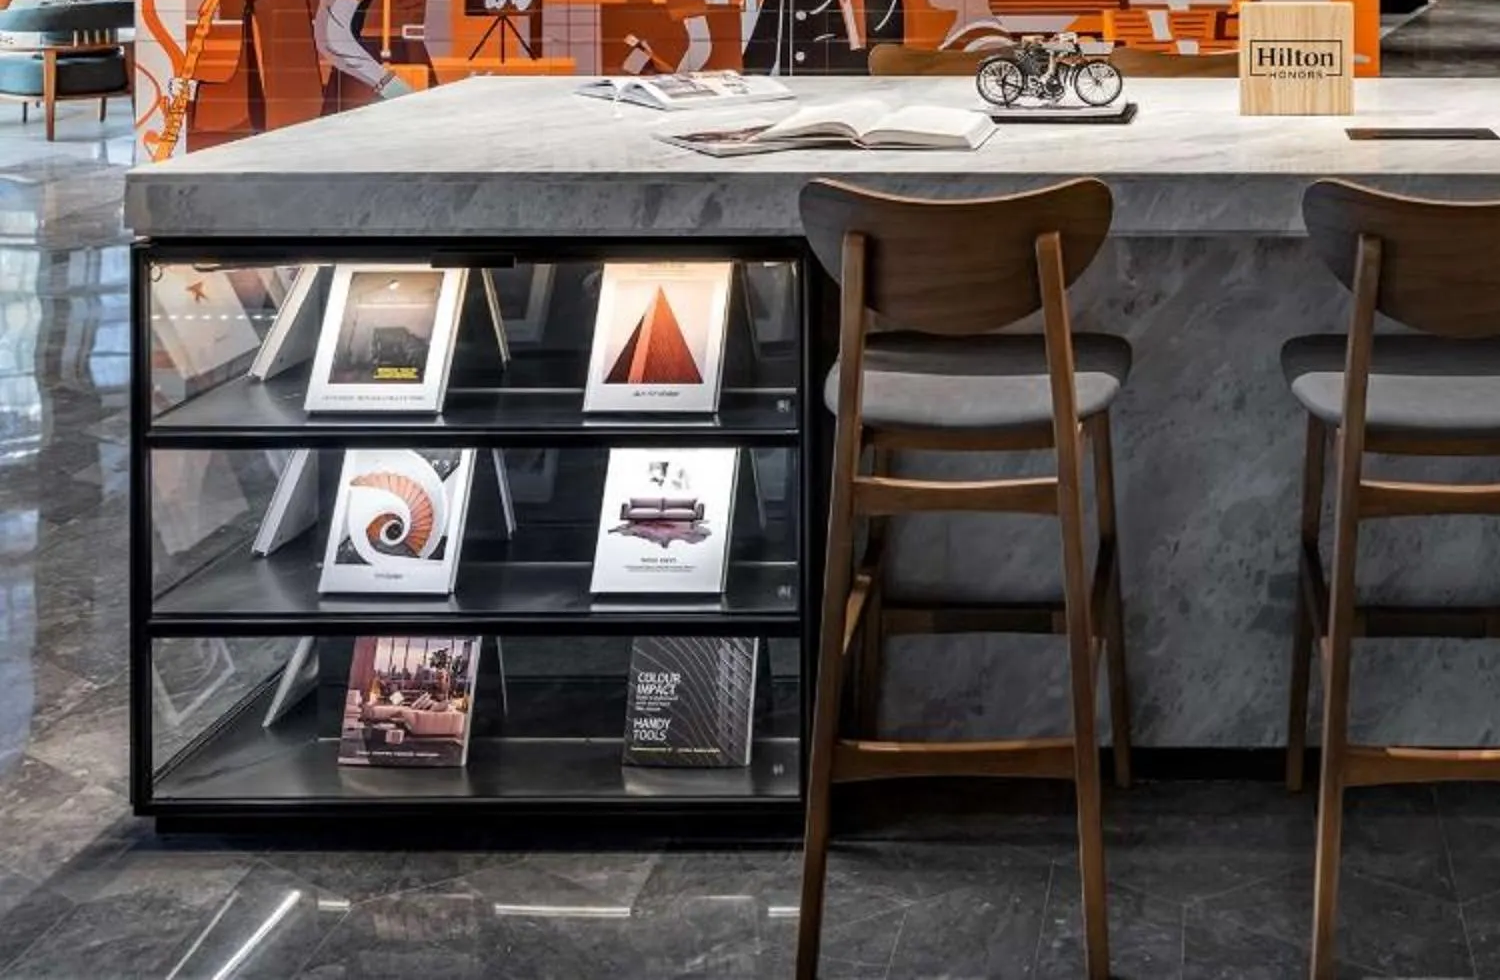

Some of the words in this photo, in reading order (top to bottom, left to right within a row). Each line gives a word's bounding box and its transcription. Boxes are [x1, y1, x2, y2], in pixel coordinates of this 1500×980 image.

[1257, 47, 1334, 67] Hilton
[1269, 70, 1324, 79] HONORS
[637, 672, 681, 683] COLOUR
[636, 683, 676, 695] IMPACT
[633, 717, 671, 729] HANDY
[633, 729, 667, 741] TOOLS
